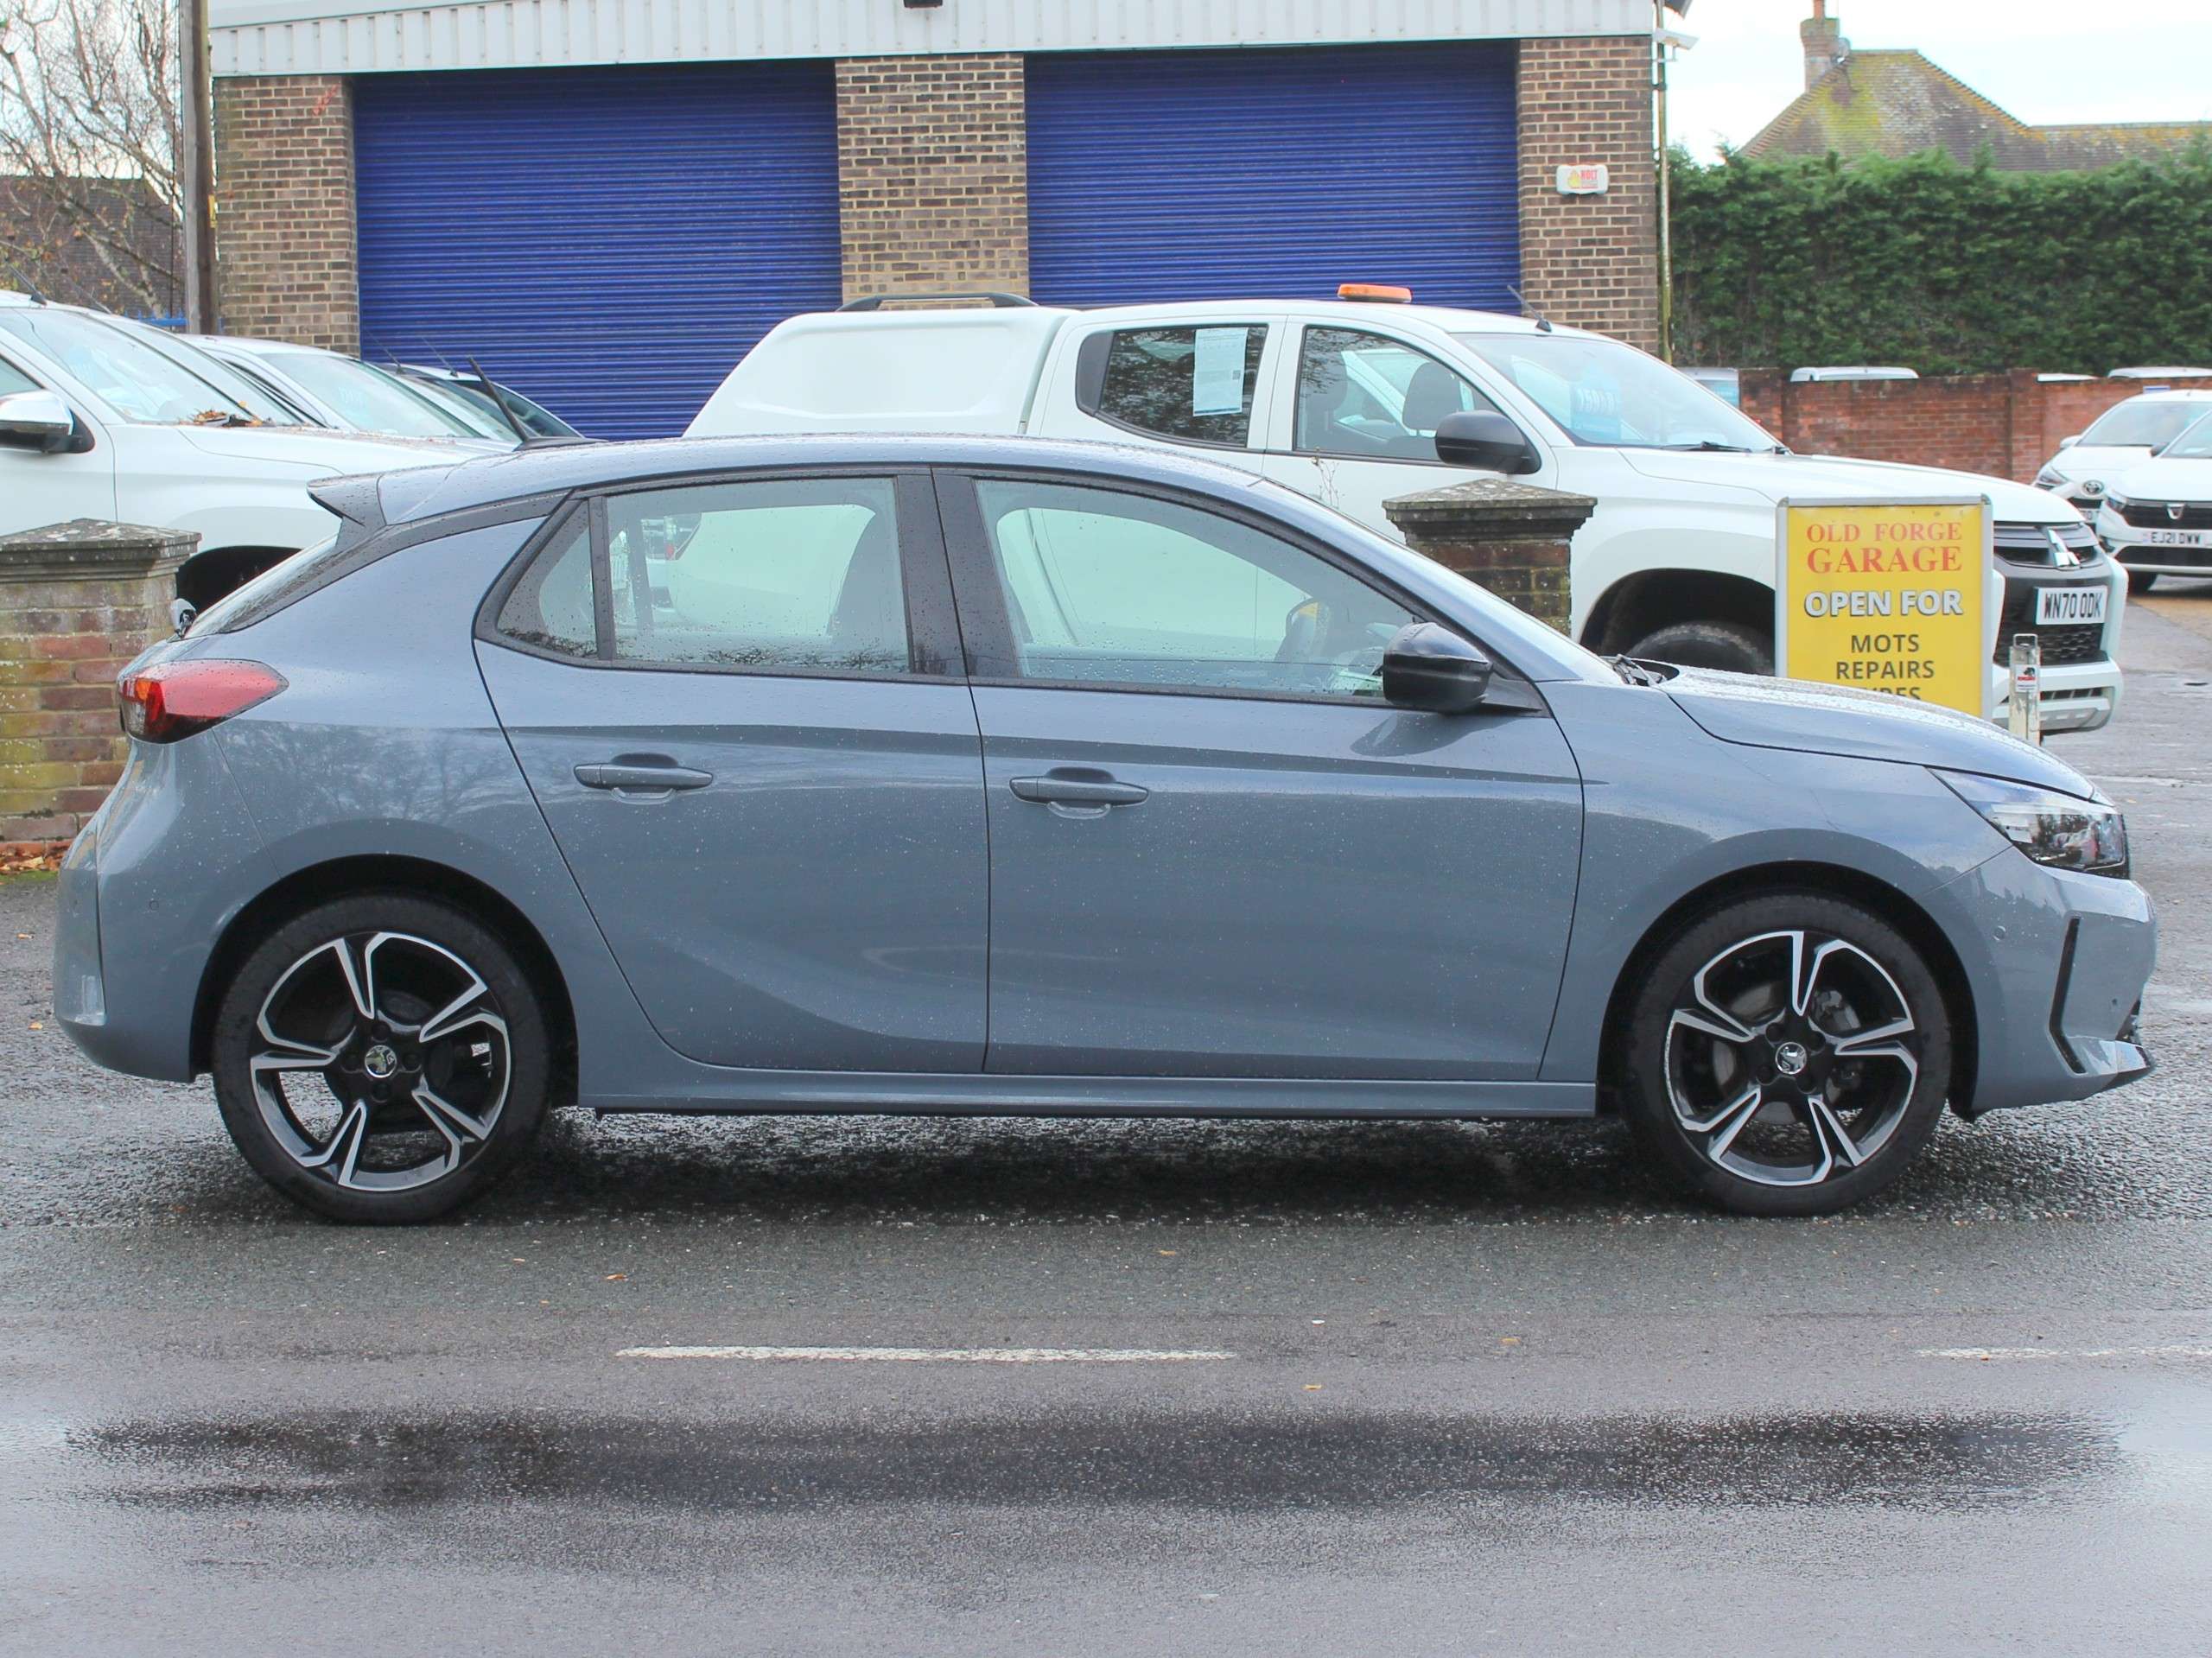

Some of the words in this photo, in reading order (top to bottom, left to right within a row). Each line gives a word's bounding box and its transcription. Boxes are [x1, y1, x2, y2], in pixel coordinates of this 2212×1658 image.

[1806, 524, 1861, 543] OLD
[1874, 522, 1963, 542] FORGE
[1807, 545, 1963, 575] GARAGE
[1803, 589, 1891, 618] OPEN
[1900, 588, 1964, 616] FOR
[2044, 592, 2078, 619] WN70
[1851, 633, 1920, 653] MOTS
[1836, 659, 1936, 680] REPAIRS
